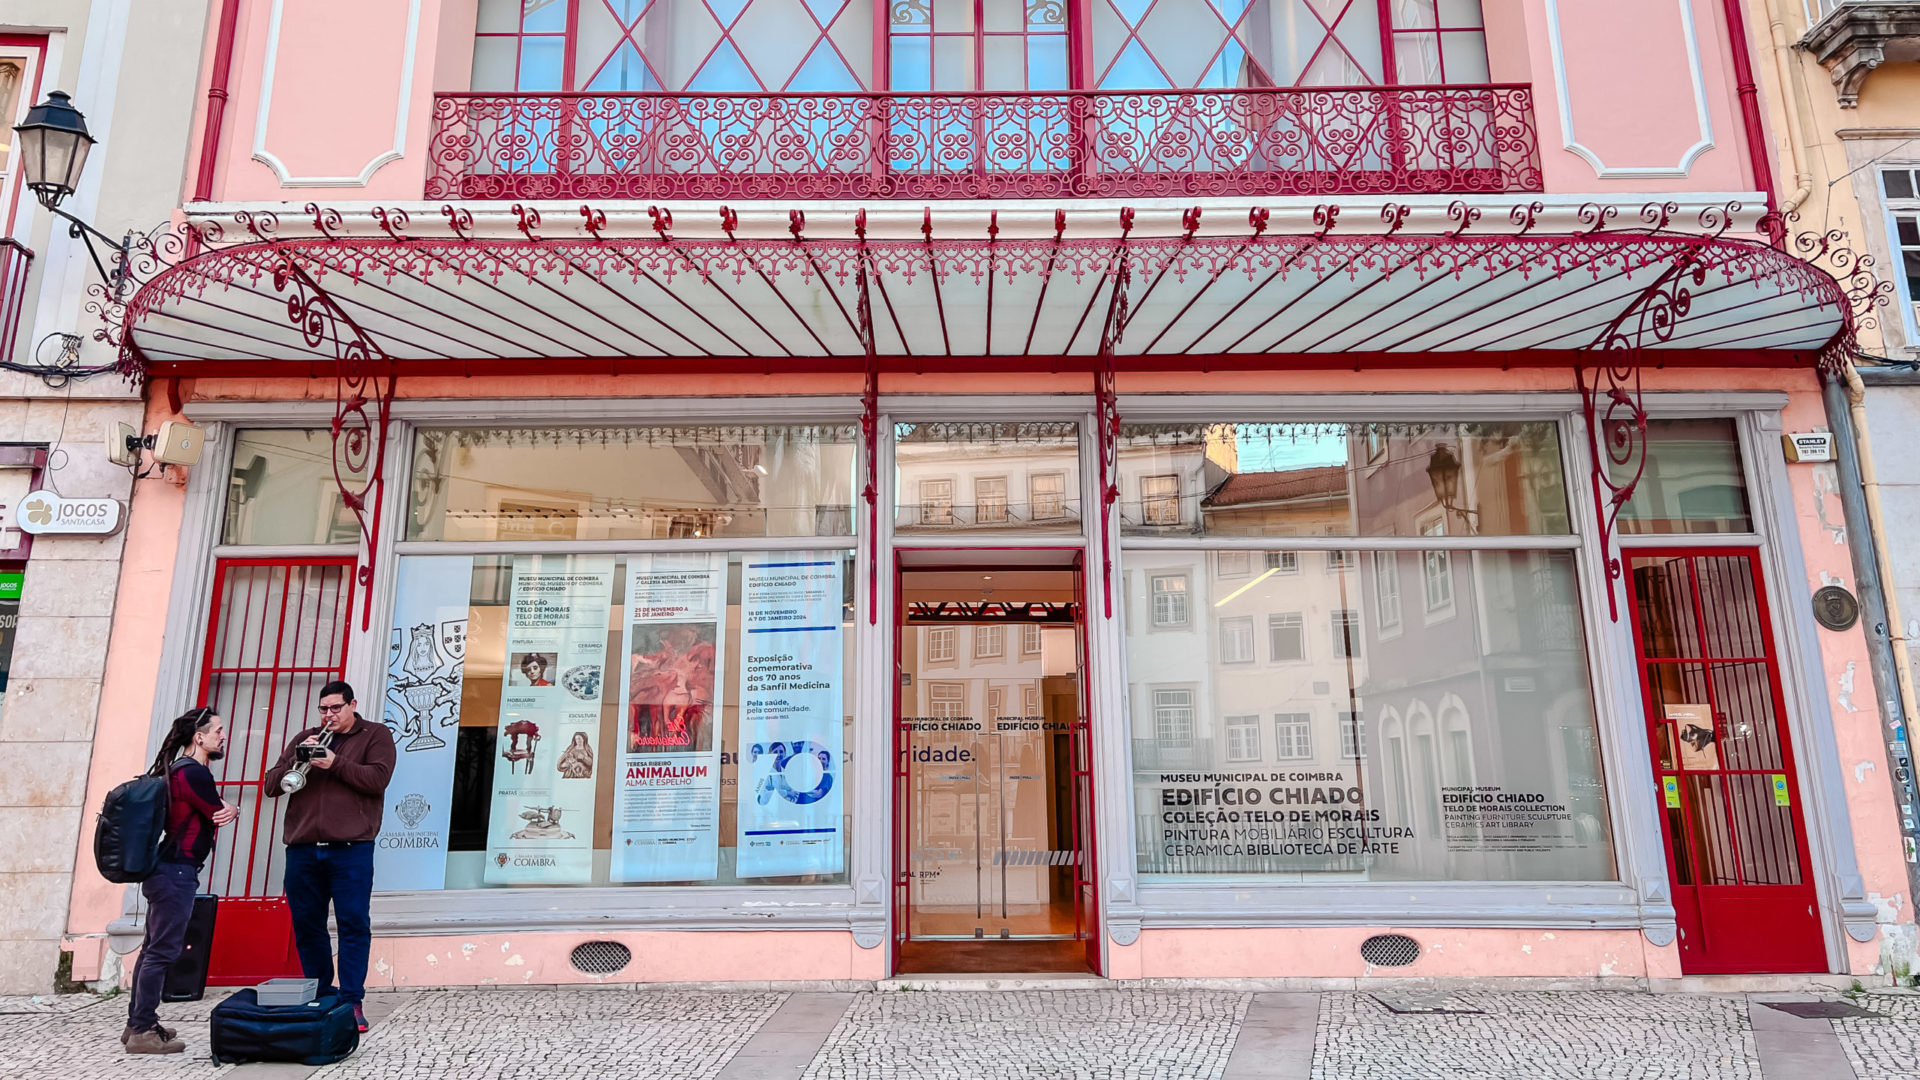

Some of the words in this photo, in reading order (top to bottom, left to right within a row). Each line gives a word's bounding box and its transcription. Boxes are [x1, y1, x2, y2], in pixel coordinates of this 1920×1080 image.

[56, 504, 108, 521] JOGOS
[748, 654, 793, 663] Exposição
[747, 663, 812, 672] comemorativa
[761, 682, 786, 690] Sanfil
[790, 681, 830, 690] Medicina
[997, 721, 1039, 731] EDIFÍCIO
[626, 766, 707, 779] ANIMALIUM
[1160, 774, 1200, 782] MUSEU
[1204, 773, 1268, 782] MUNICIPAL
[1270, 773, 1286, 781] DE
[1289, 773, 1343, 781] COIMBRA
[1162, 783, 1262, 805] EDIFÍCIO
[1269, 787, 1363, 805] CHIADO
[1443, 791, 1493, 803] EDIFÍCIO
[1496, 794, 1544, 803] CHIADO
[1163, 807, 1240, 827] COLEÇÃO
[1244, 811, 1284, 822] TELO
[1289, 810, 1310, 822] DE
[1315, 810, 1380, 822] MORAIS
[1164, 830, 1230, 840] PINTURA
[1234, 825, 1323, 840] MOBILIÁRIO
[1328, 827, 1414, 839] ESCULTURA
[379, 837, 439, 848] COIMBRA
[1165, 845, 1243, 856] CERAMICA
[1247, 844, 1333, 856] BIBLIOTECA
[1337, 843, 1357, 854] DE
[1361, 843, 1399, 854] ARTE
